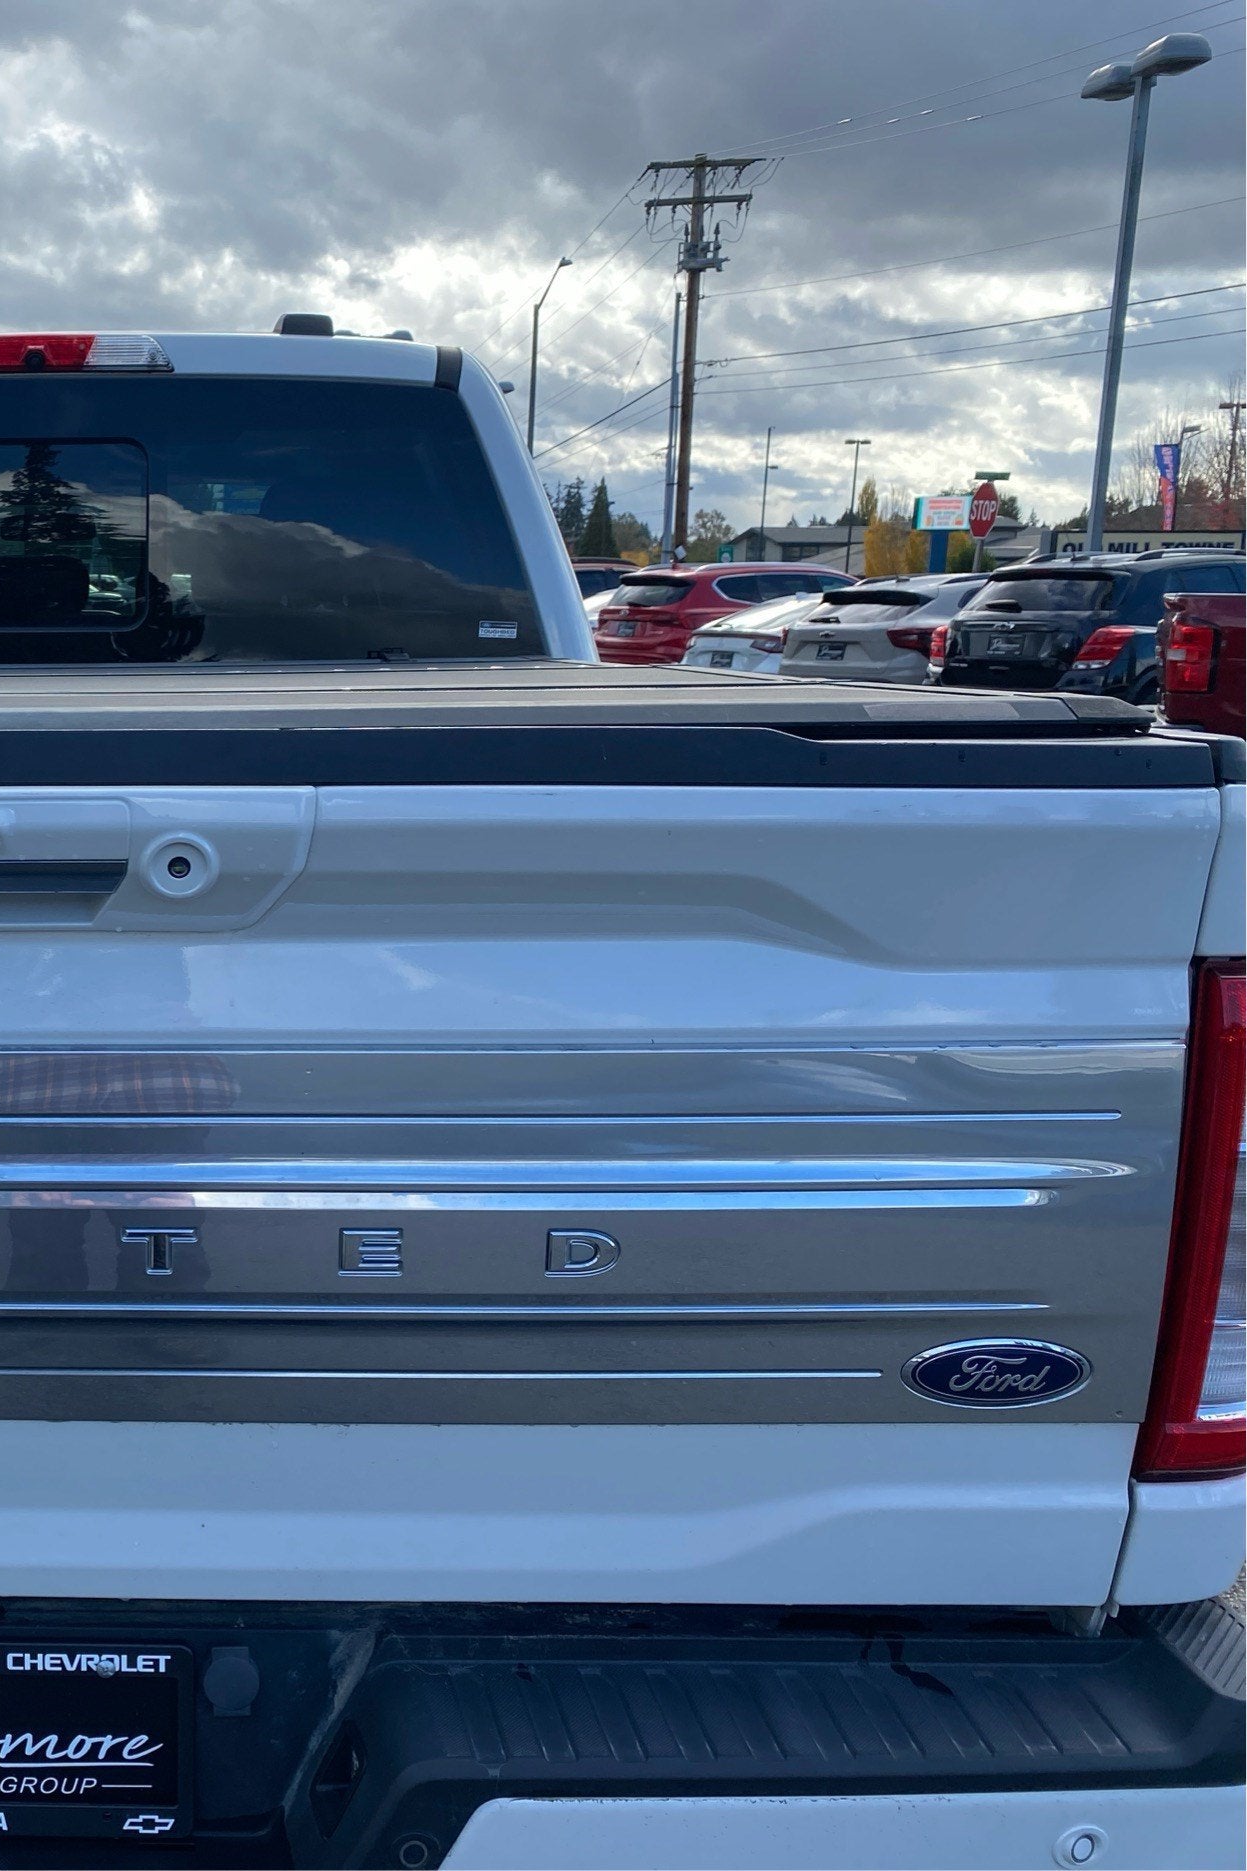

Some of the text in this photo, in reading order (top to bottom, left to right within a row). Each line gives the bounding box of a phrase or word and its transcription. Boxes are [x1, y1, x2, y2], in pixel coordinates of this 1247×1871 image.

[970, 500, 996, 521] STOP
[949, 1355, 1051, 1392] Ford
[6, 1652, 171, 1673] CHEVROLET
[0, 1776, 98, 1795] GROUP
